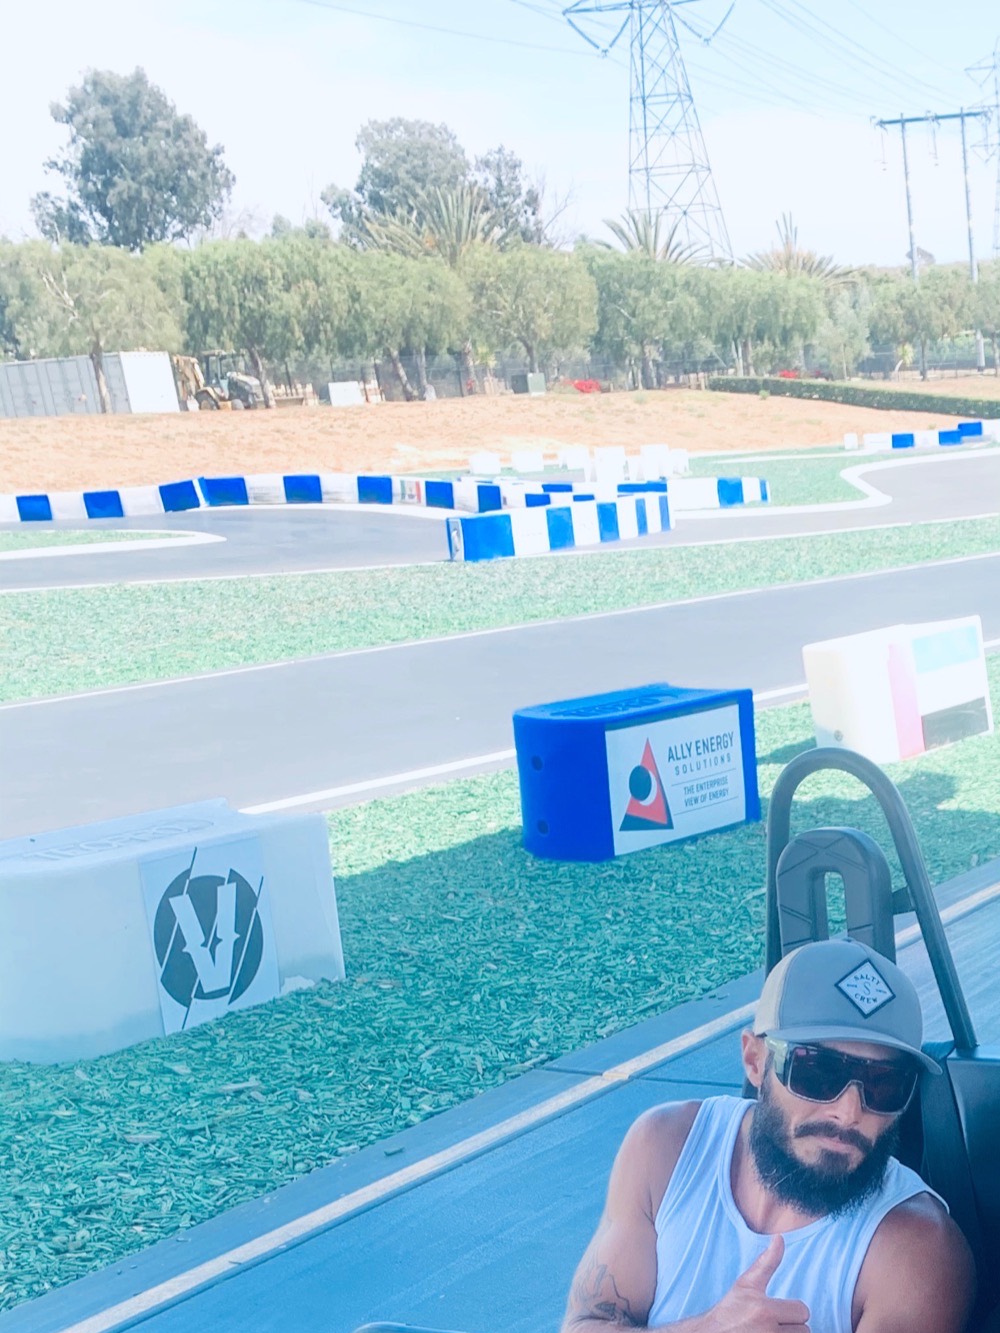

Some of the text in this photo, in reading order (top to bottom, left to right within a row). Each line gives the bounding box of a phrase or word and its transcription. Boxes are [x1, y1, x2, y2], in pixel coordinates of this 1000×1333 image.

[667, 731, 734, 763] ALLY ENERGY
[674, 753, 731, 776] SOLUTIONS
[683, 775, 729, 795] THE ENTERPRISE
[684, 788, 730, 807] VIEW OF ENERGY
[853, 973, 880, 986] SALTY
[854, 993, 878, 1004] CREW
